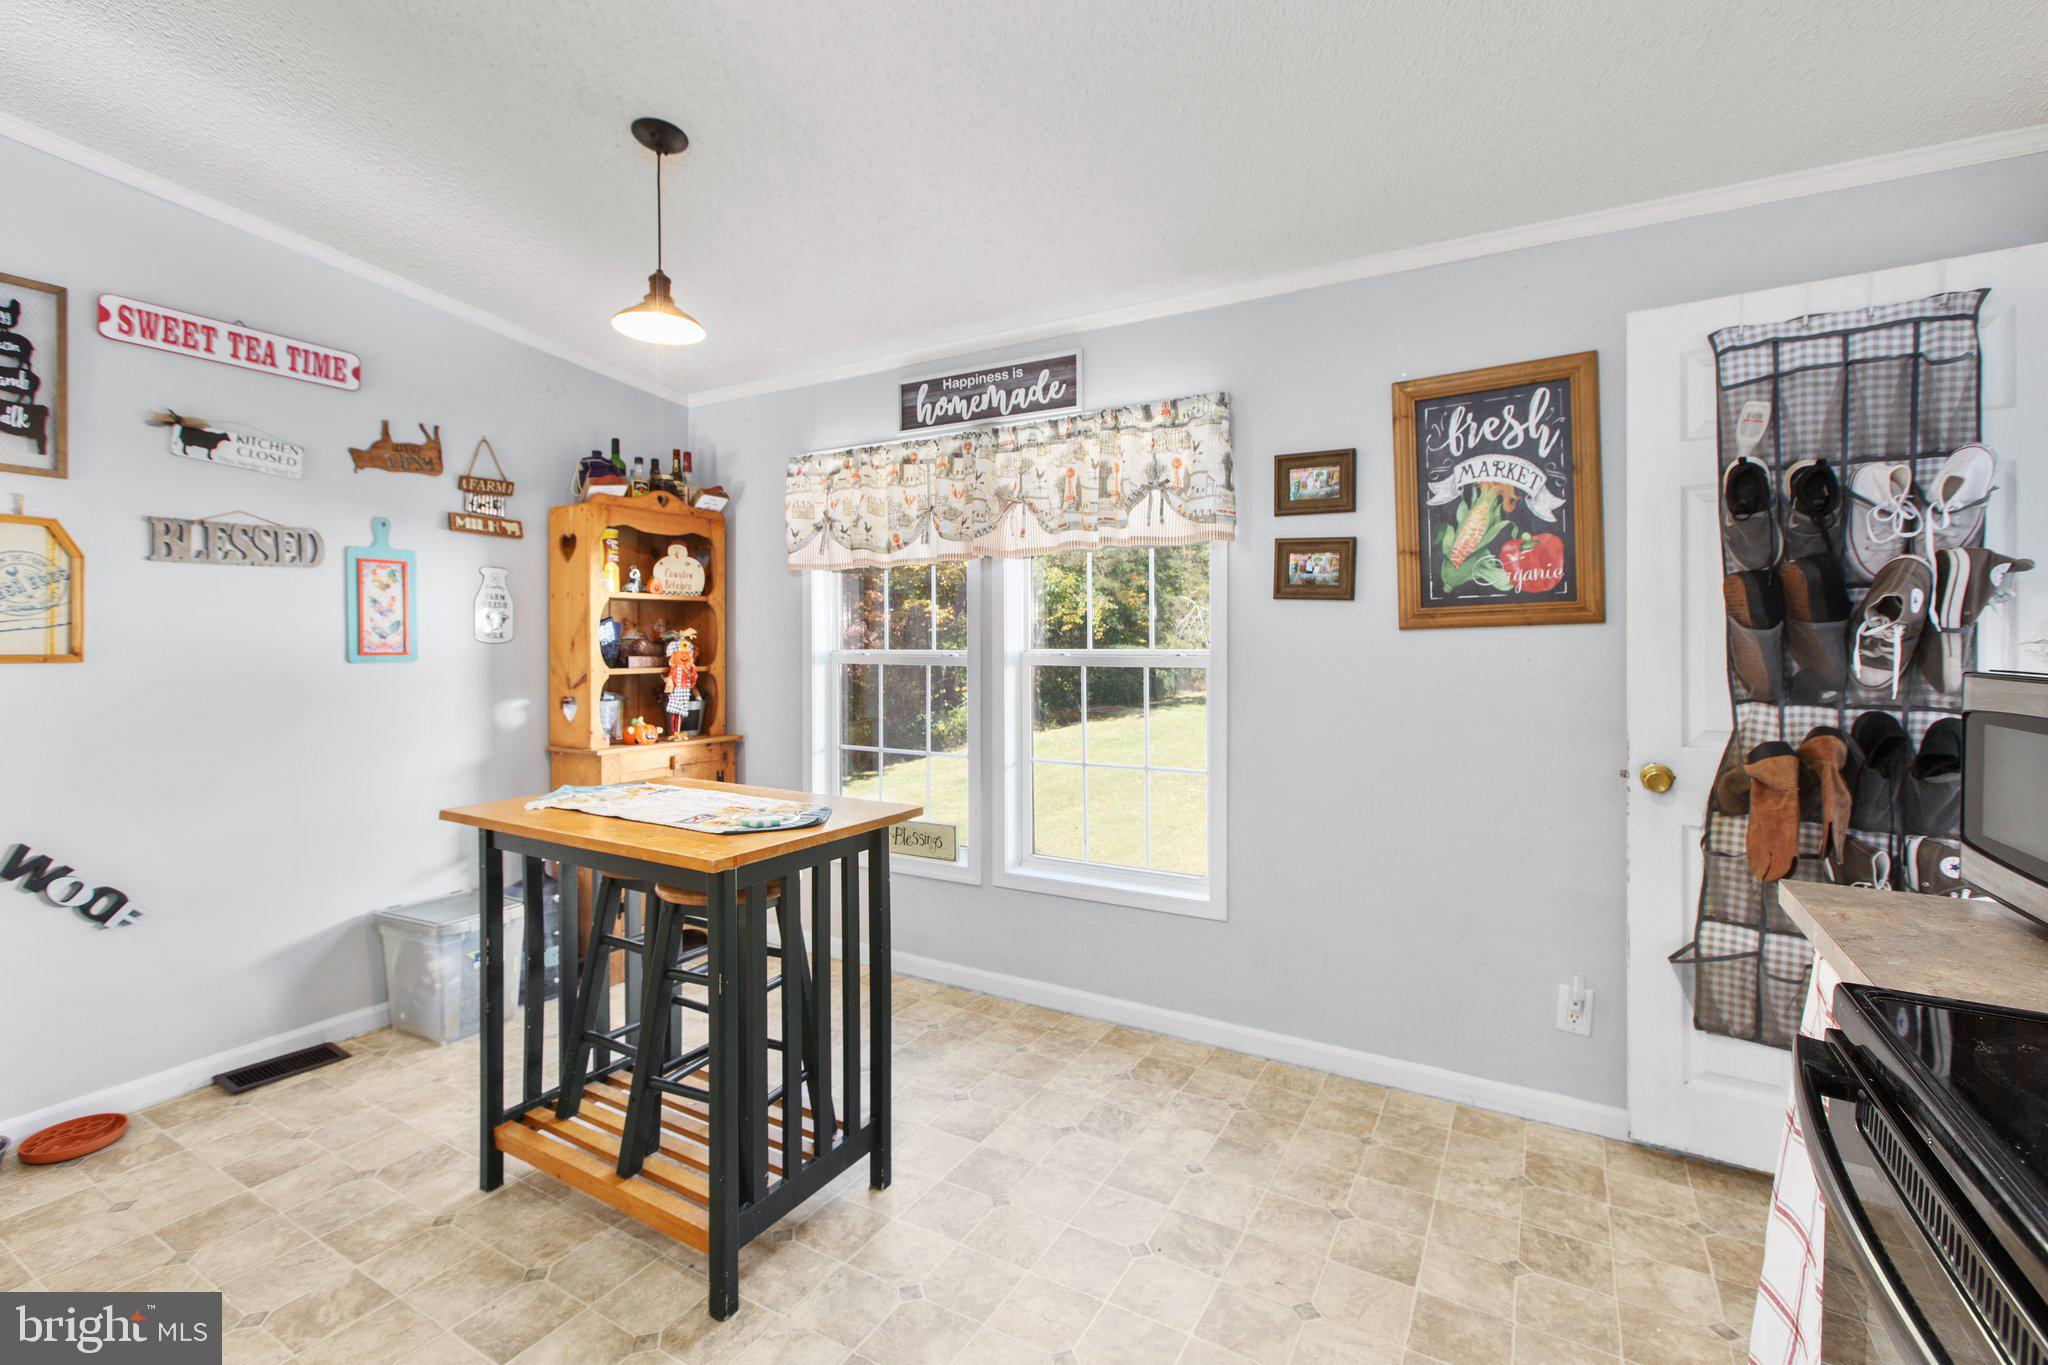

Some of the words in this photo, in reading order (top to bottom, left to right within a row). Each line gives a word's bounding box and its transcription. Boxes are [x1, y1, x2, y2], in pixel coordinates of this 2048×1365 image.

[117, 304, 217, 355] SWEET
[227, 329, 278, 370] TEA
[285, 344, 348, 384] TIME
[942, 370, 1009, 391] Happiness
[1012, 366, 1024, 379] is
[916, 368, 1067, 426] homemade
[1427, 386, 1561, 457] fresh
[236, 433, 304, 456] KITCHEN
[237, 446, 298, 467] CLOSED
[1457, 460, 1543, 491] MARKET
[455, 515, 502, 533] MILK
[145, 516, 325, 568] BLESSED
[1472, 555, 1564, 593] Organic
[894, 826, 943, 851] Blessings
[0, 842, 142, 929] WOOF
